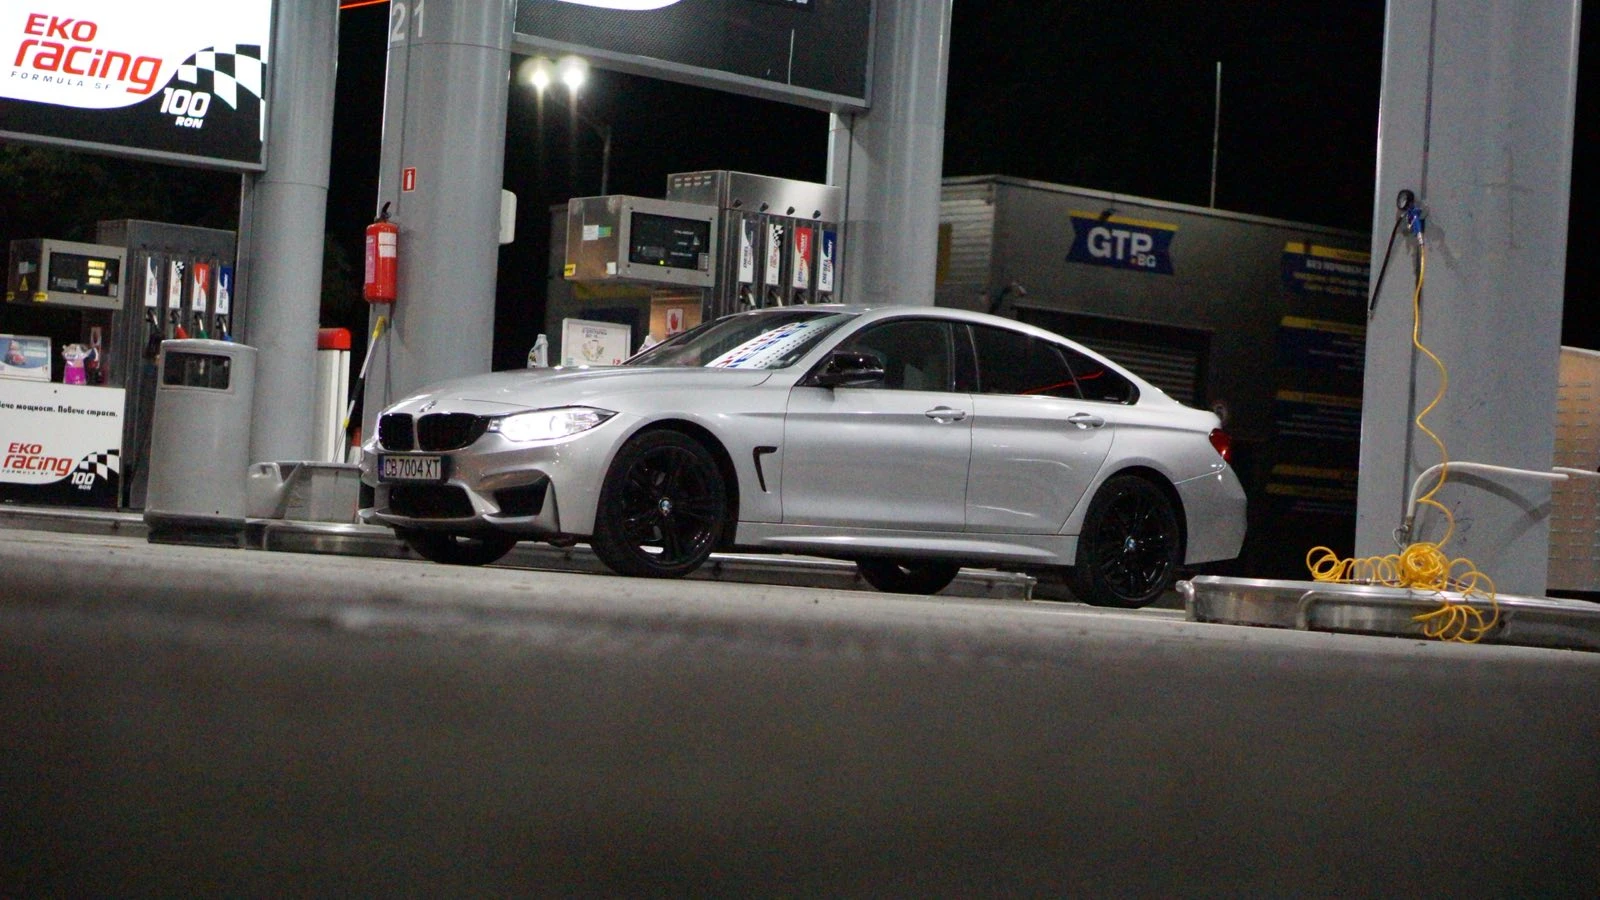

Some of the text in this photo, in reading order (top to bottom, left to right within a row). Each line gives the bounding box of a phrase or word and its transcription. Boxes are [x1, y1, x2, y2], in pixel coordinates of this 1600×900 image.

[24, 13, 98, 43] EKO
[390, 0, 425, 42] 21
[14, 39, 163, 95] racing
[10, 70, 84, 87] FORMULA
[160, 87, 211, 118] 100
[175, 116, 203, 129] RON
[1087, 226, 1153, 260] GTP
[8, 442, 42, 454] EKO
[3, 454, 73, 476] racing
[399, 459, 424, 477] 7004
[71, 472, 96, 485] 100
